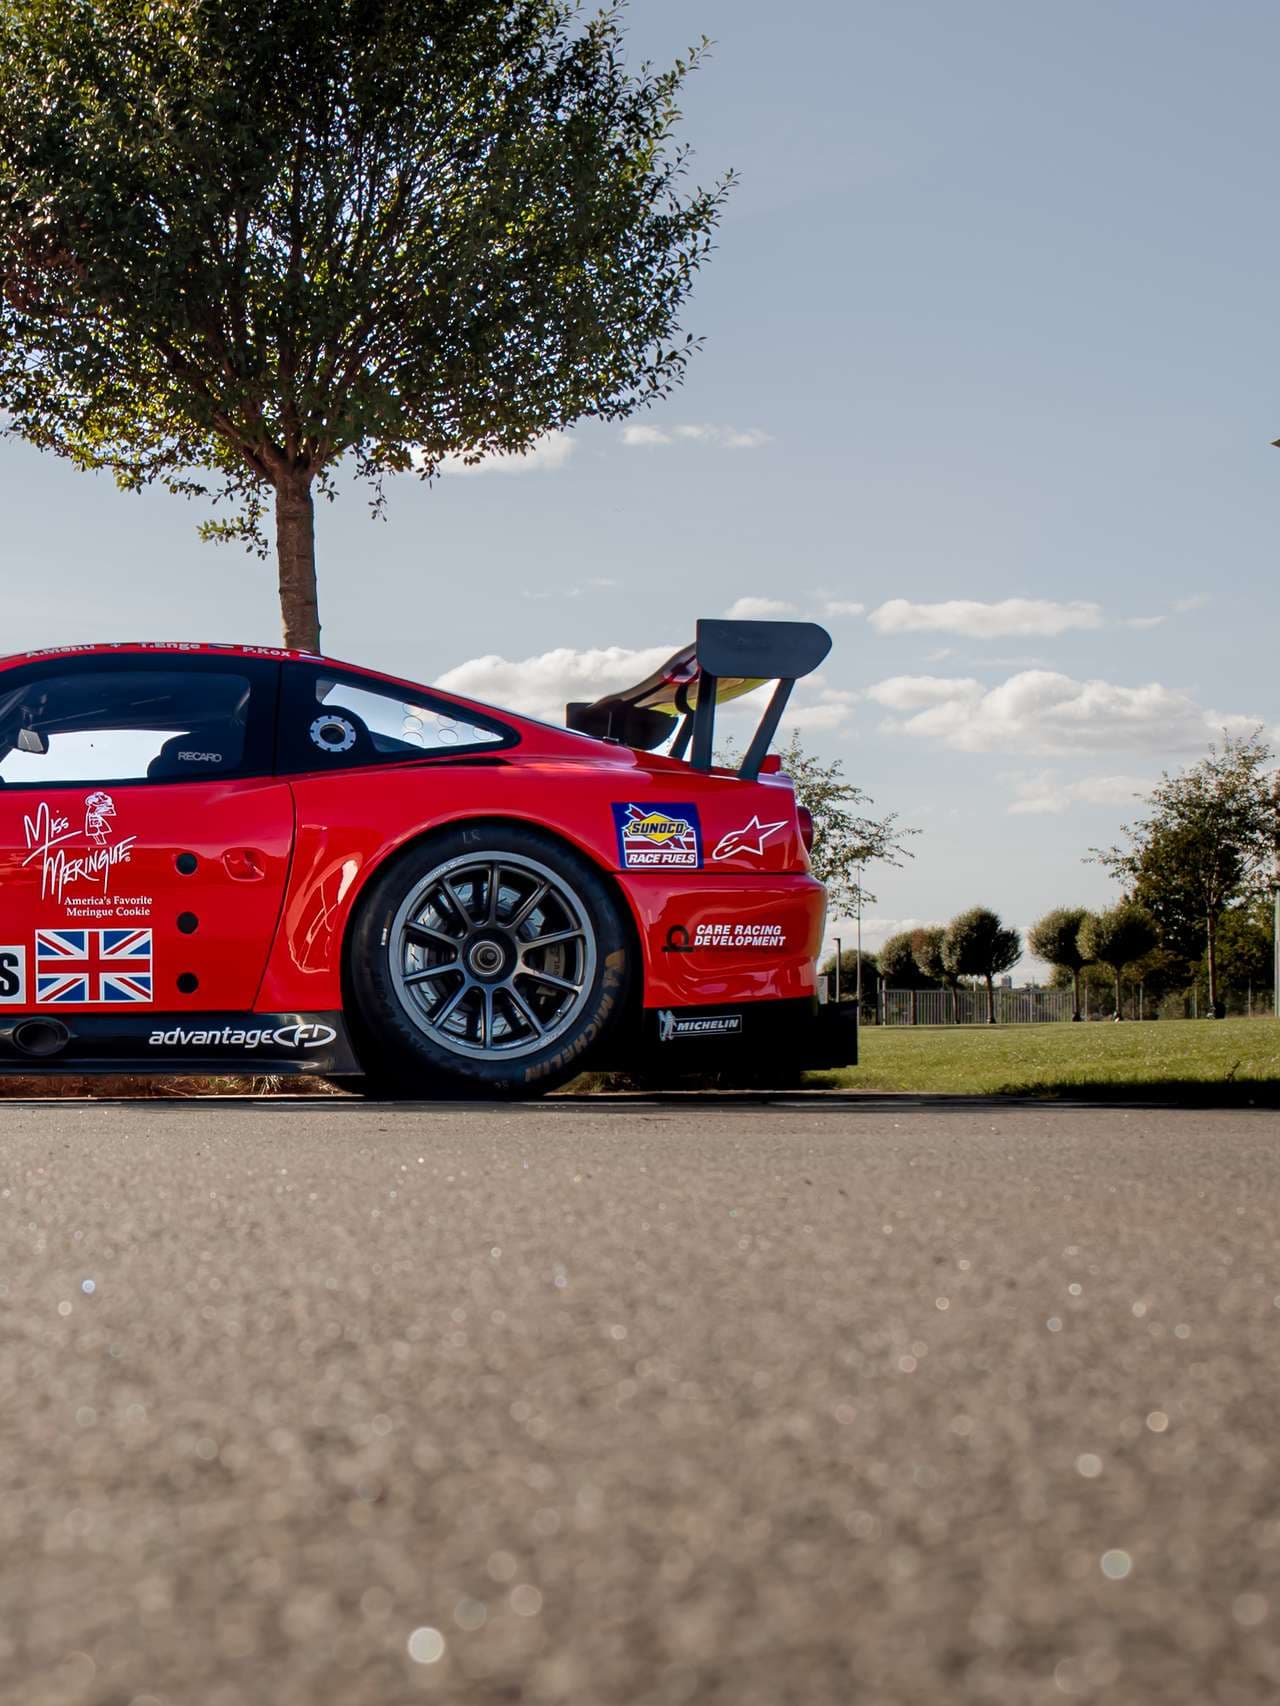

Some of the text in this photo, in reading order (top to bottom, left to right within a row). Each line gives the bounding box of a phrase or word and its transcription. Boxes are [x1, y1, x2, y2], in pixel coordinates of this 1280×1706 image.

[242, 646, 291, 657] P.Kox
[178, 752, 222, 762] RECARO
[632, 823, 684, 833] SUNOCO
[628, 853, 695, 863] RACE FUELS
[64, 895, 153, 905] America's Favorite
[66, 907, 151, 918] Meringue Cookie
[696, 924, 782, 935] CARE RACING
[694, 935, 786, 946] DEVELOPMENT
[676, 1019, 739, 1032] MICHELIN
[148, 1026, 274, 1049] advantage
